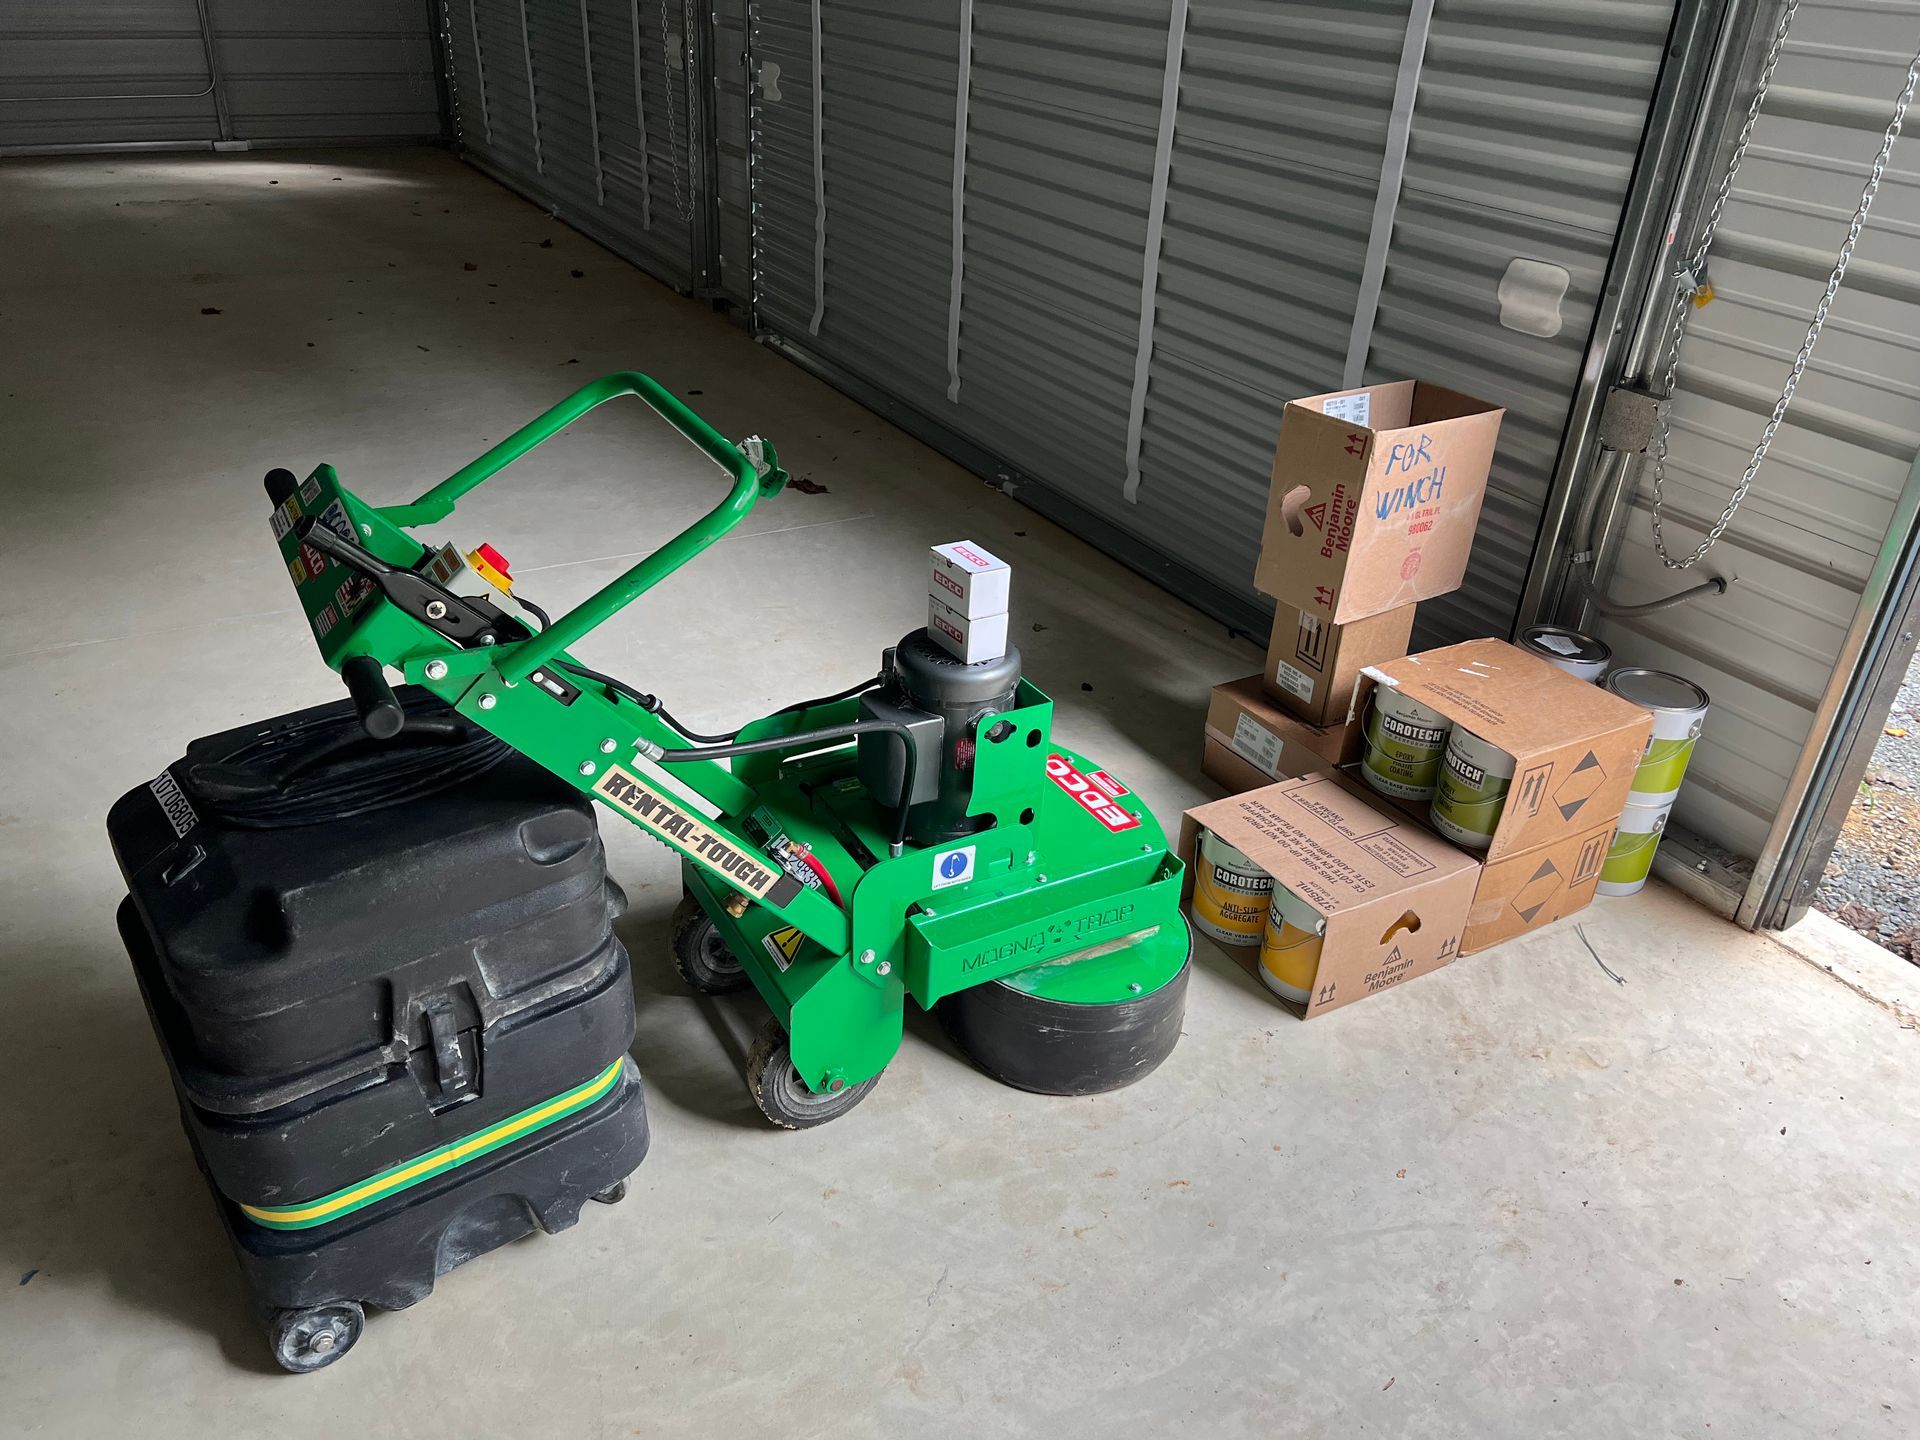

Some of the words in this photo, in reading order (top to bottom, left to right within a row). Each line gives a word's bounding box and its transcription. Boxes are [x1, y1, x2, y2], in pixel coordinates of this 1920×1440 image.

[1384, 433, 1433, 476] FOR
[1375, 466, 1447, 521] WINCH
[1320, 483, 1346, 559] Benjamin
[1335, 499, 1357, 553] Moore
[954, 546, 988, 567] EDCO
[935, 571, 963, 596] EDCO
[935, 616, 962, 641] EDCO
[1383, 716, 1442, 742] COROTECH
[1395, 750, 1416, 762] EPOXY
[1389, 766, 1414, 779] COATING
[1046, 758, 1133, 827] EDCO
[152, 773, 197, 834] 10706805
[1250, 800, 1272, 813] CAER
[1241, 814, 1265, 829] DROP
[1268, 813, 1295, 829] DEJAR
[602, 772, 771, 892] RENTAL-TOUGH
[1261, 828, 1280, 839] NOT
[1273, 826, 1292, 837] PAS
[1276, 839, 1304, 857] UP-DO
[1287, 836, 1324, 860] HAUT-NE
[1299, 856, 1321, 870] SIDE
[1318, 860, 1334, 869] EN
[1330, 858, 1356, 873] LADO
[1216, 868, 1274, 889] COROTECH
[1317, 870, 1339, 884] THIS
[1352, 873, 1376, 888] ESTE
[1292, 879, 1337, 910] 3785mL
[1350, 883, 1367, 892] CE
[1219, 909, 1260, 924] AGGREGATE
[1222, 901, 1259, 914] ANTI-SLIP
[1363, 958, 1414, 985] Benjamin
[1368, 973, 1404, 993] Moore
